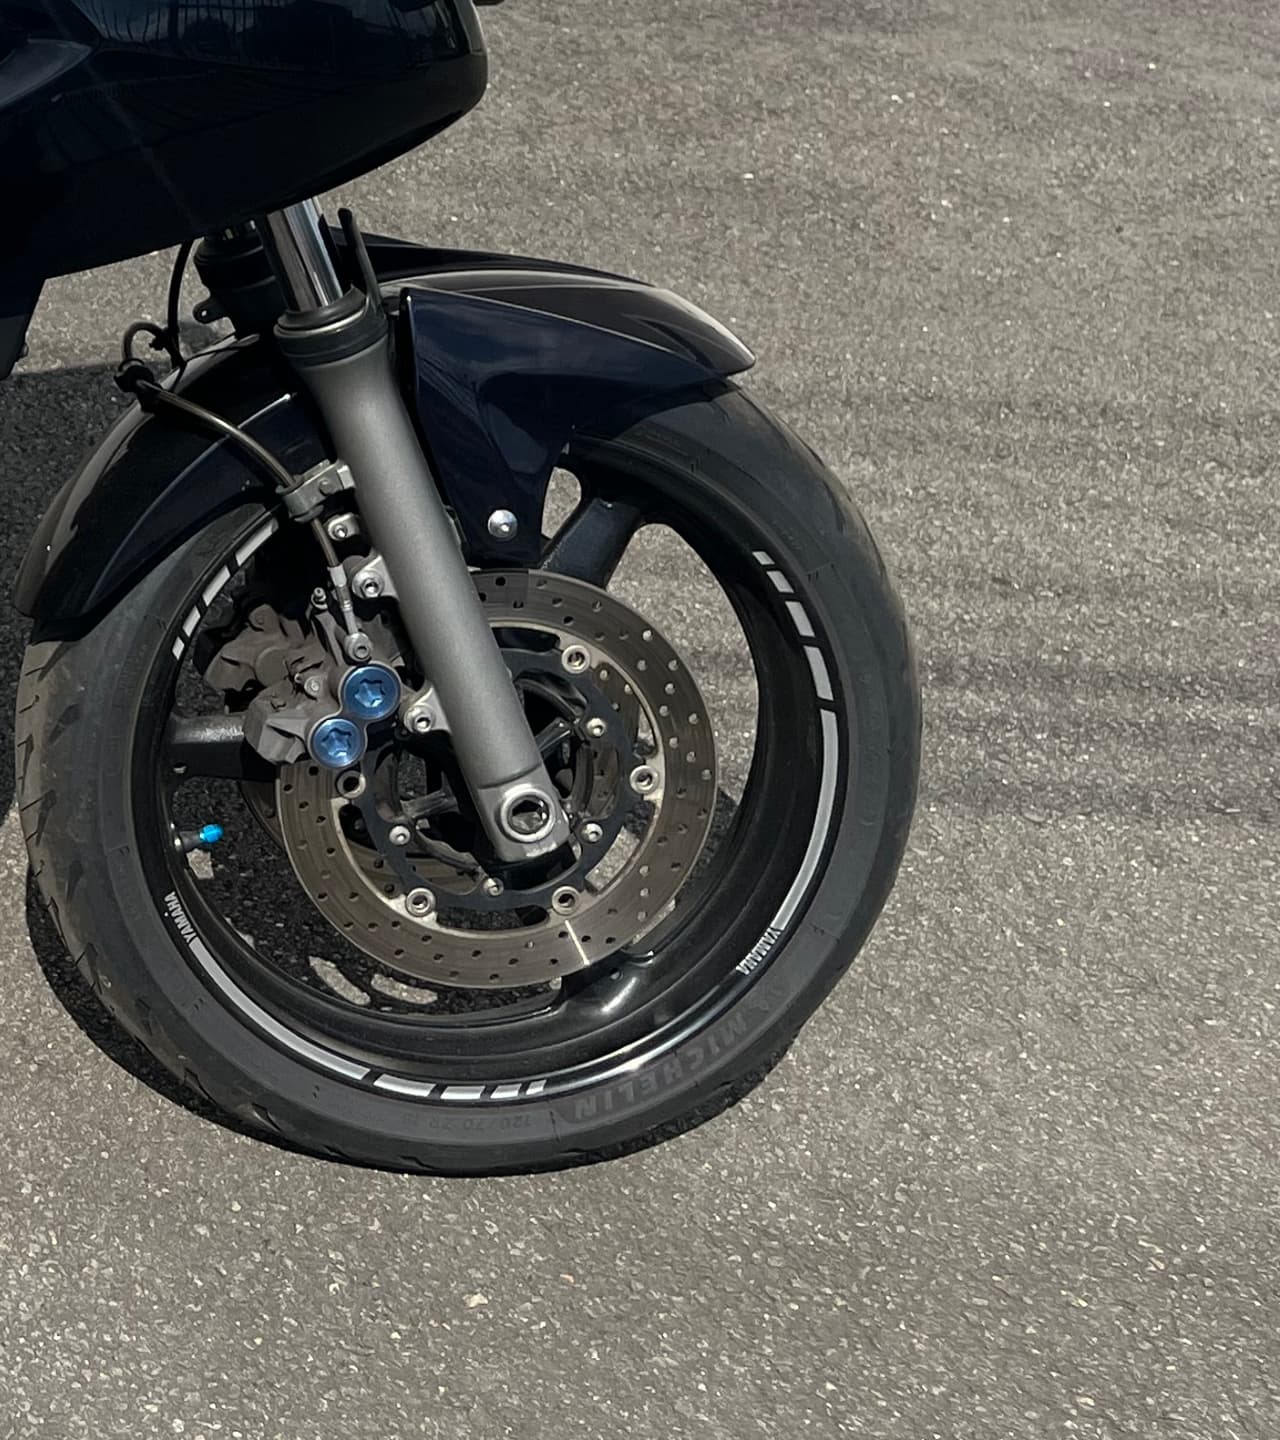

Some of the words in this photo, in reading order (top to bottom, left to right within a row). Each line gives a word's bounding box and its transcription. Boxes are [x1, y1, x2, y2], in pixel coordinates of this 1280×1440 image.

[163, 890, 196, 945] YAMAHA
[735, 926, 782, 977] YAMAHA
[573, 1012, 753, 1121] MICHELIN
[462, 1112, 532, 1132] 120/70
